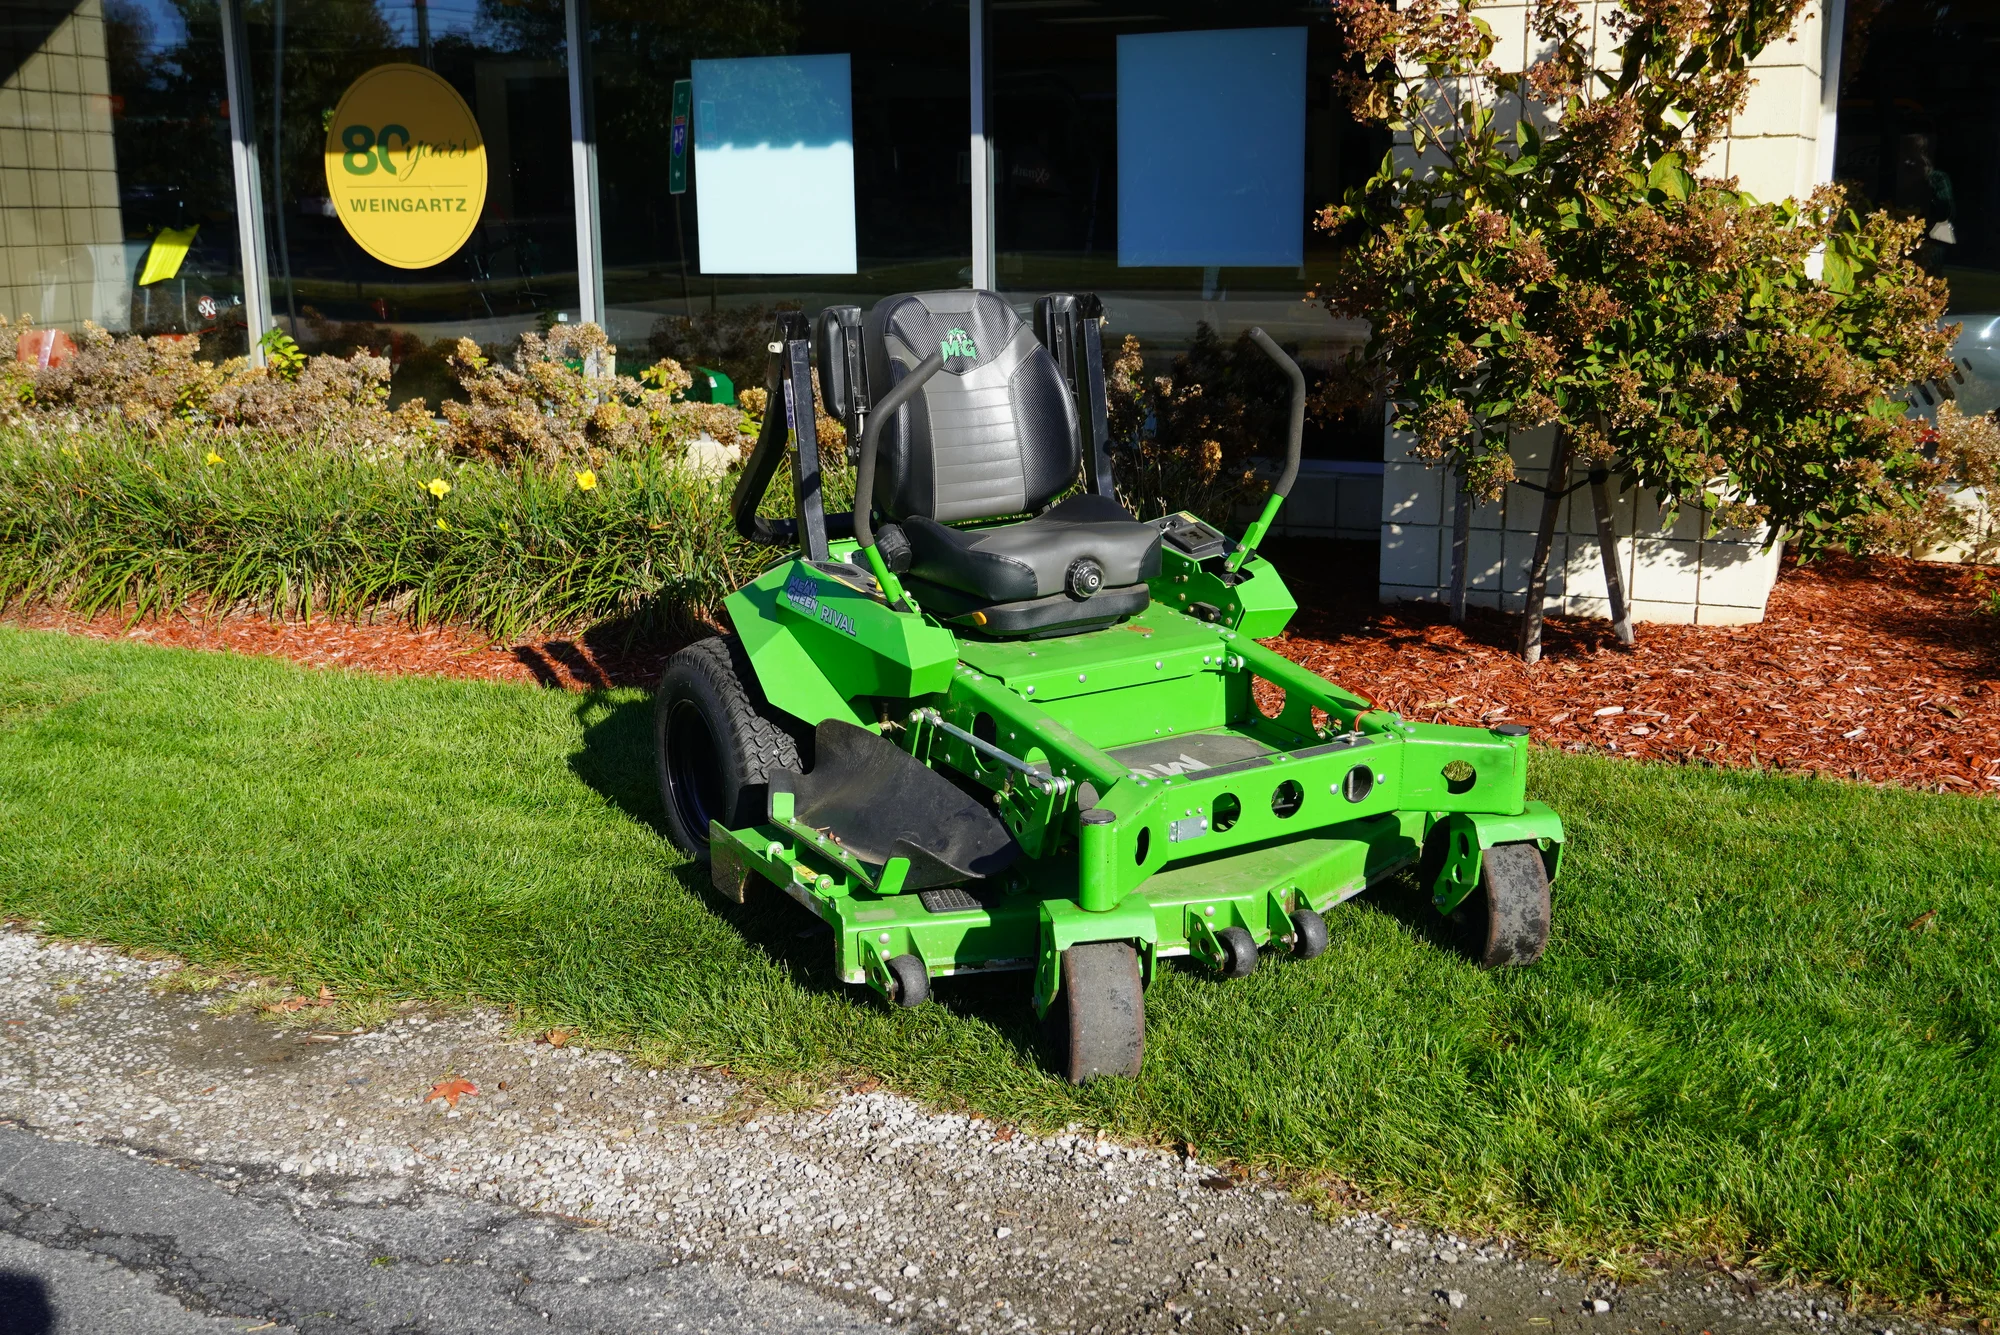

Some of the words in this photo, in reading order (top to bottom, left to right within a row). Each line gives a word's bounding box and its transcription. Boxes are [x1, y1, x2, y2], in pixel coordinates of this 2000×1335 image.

[399, 137, 468, 182] years
[350, 198, 467, 213] WEINGARTZ
[941, 339, 977, 363] MG
[787, 585, 819, 613] GREEN
[790, 575, 817, 598] MEAN
[820, 604, 857, 637] RIVAL
